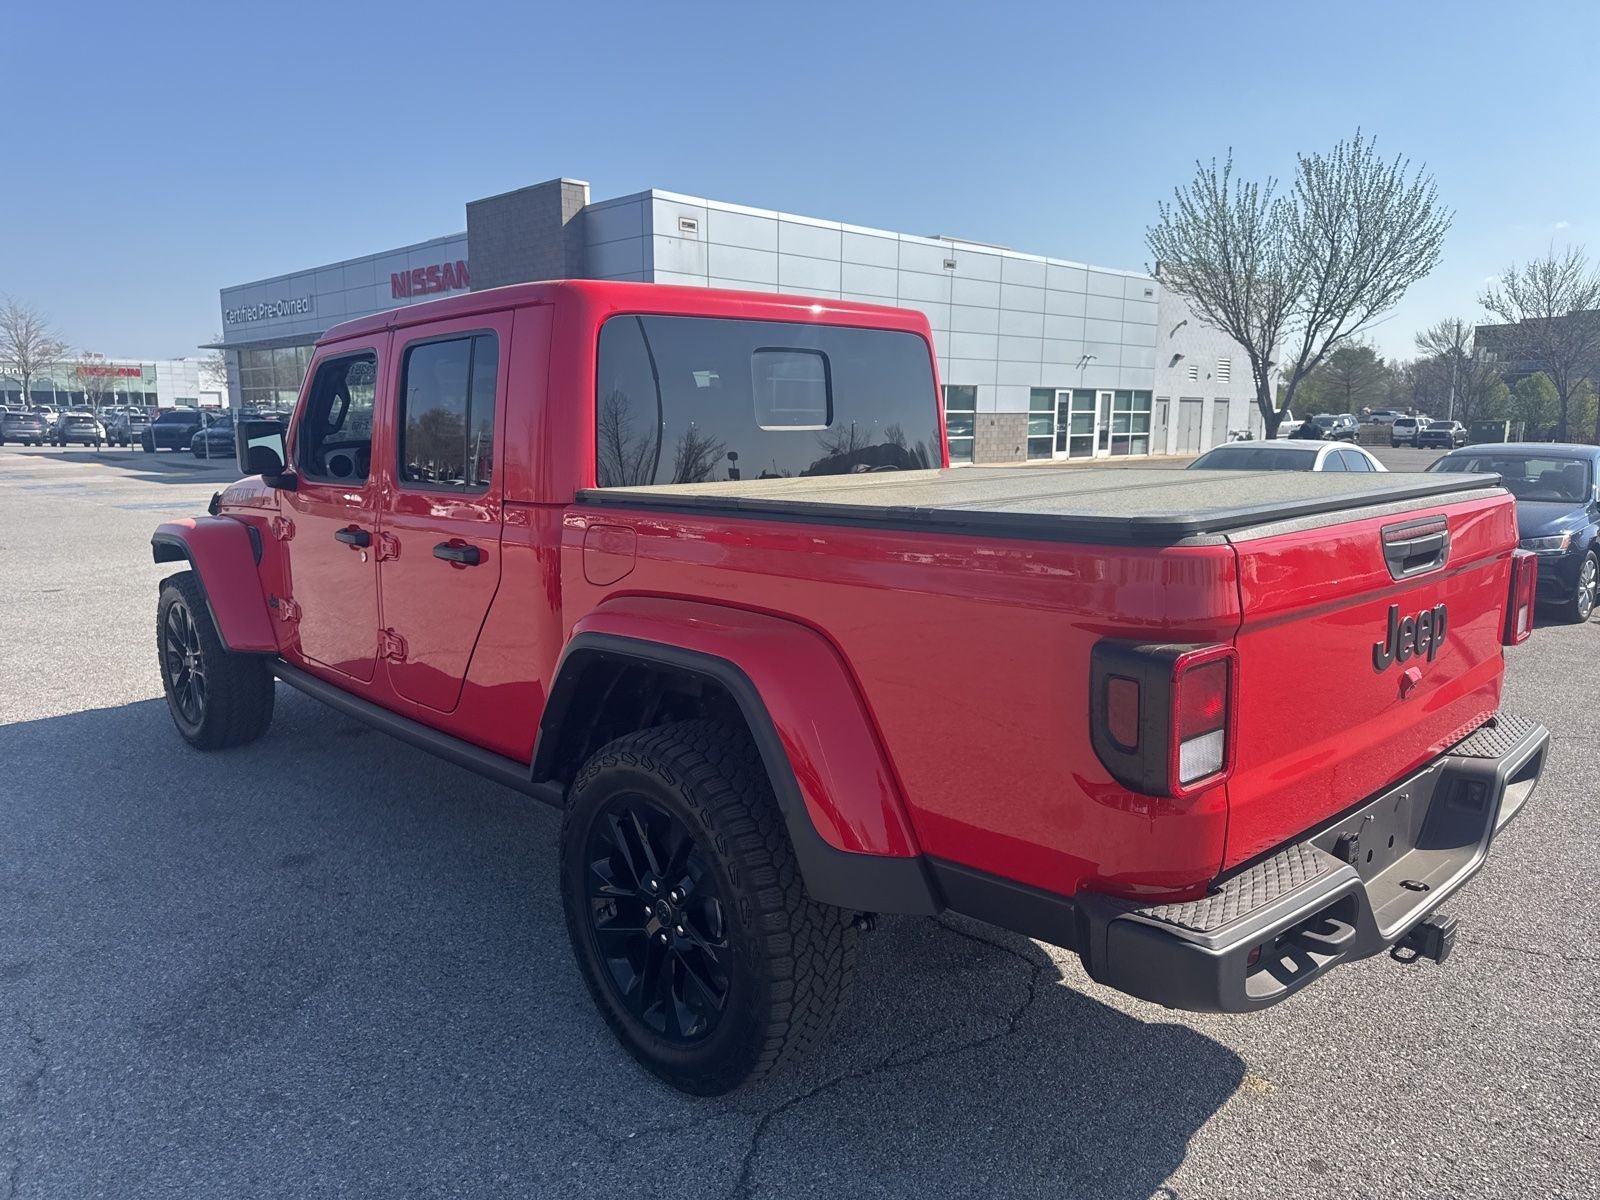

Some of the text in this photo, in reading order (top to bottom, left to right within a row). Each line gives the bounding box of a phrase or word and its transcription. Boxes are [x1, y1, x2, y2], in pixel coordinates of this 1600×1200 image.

[391, 260, 470, 299] NISSAN
[225, 295, 311, 324] Certified Pre-Owned
[1373, 603, 1447, 671] Jeep
